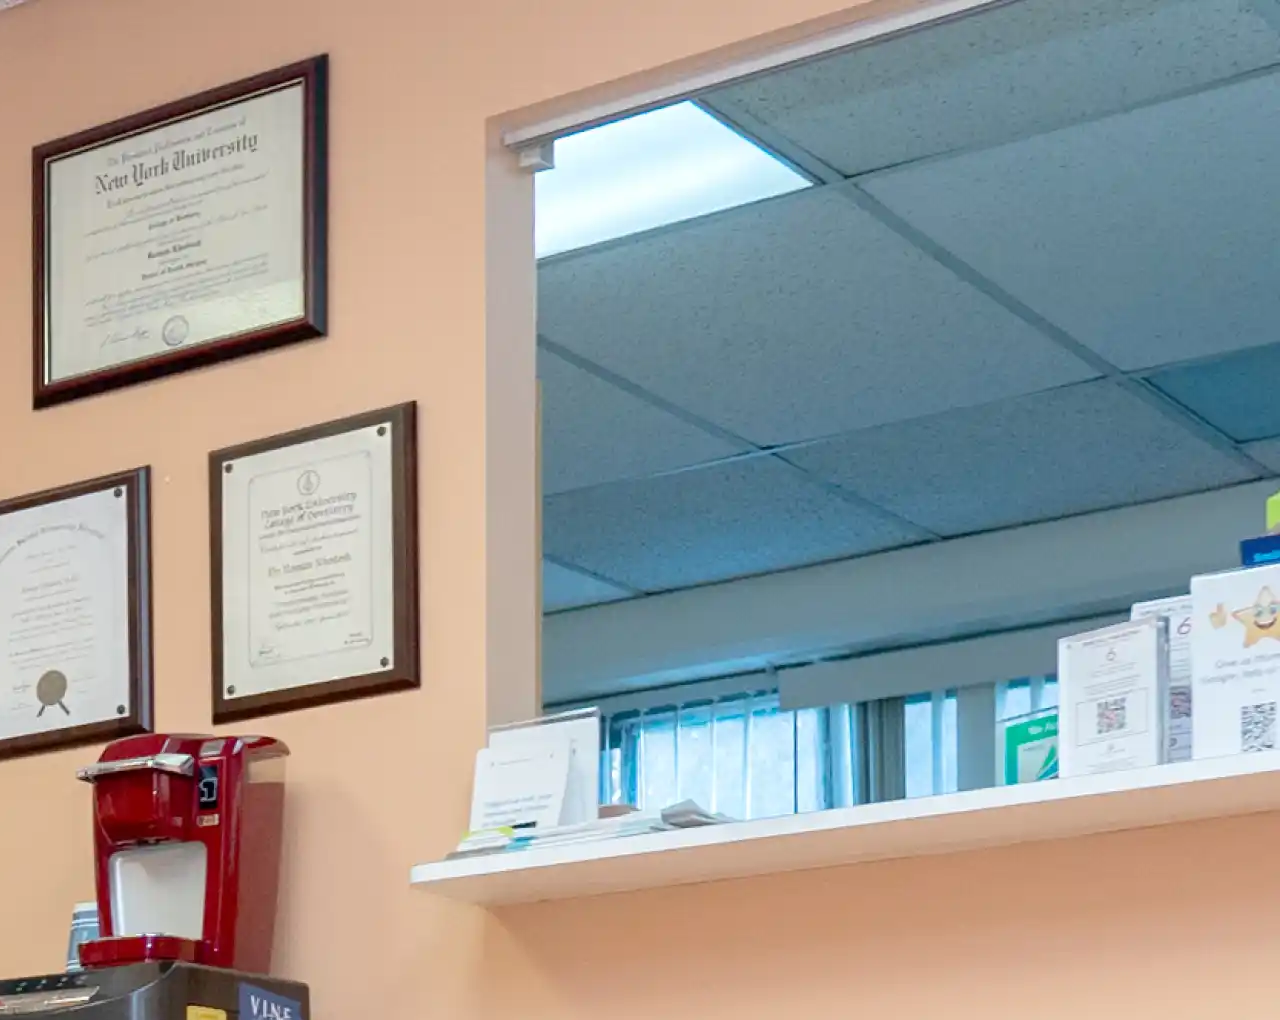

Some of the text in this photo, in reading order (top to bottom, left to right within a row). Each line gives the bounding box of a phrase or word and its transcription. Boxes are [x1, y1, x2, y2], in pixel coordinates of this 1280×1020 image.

[95, 173, 128, 195] New
[132, 157, 170, 187] York
[172, 133, 259, 171] University
